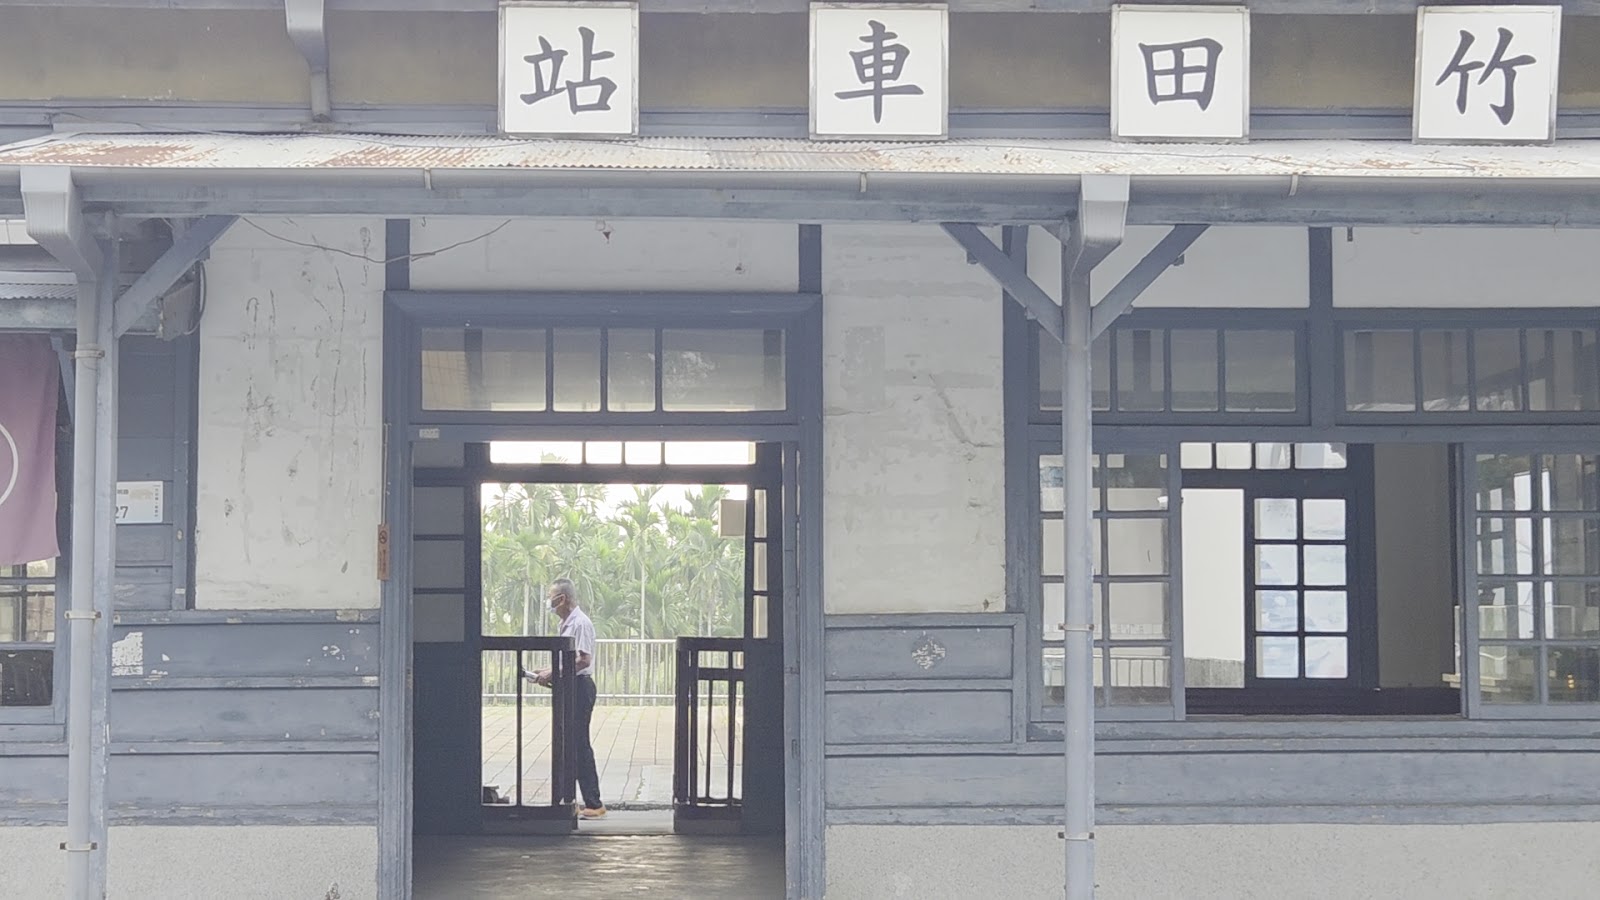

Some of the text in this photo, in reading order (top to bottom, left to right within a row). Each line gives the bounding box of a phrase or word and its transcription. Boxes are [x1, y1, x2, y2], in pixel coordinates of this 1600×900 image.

[520, 26, 617, 115] 站
[834, 20, 924, 124] 車
[1138, 38, 1223, 111] 田
[1436, 27, 1537, 126] 竹
